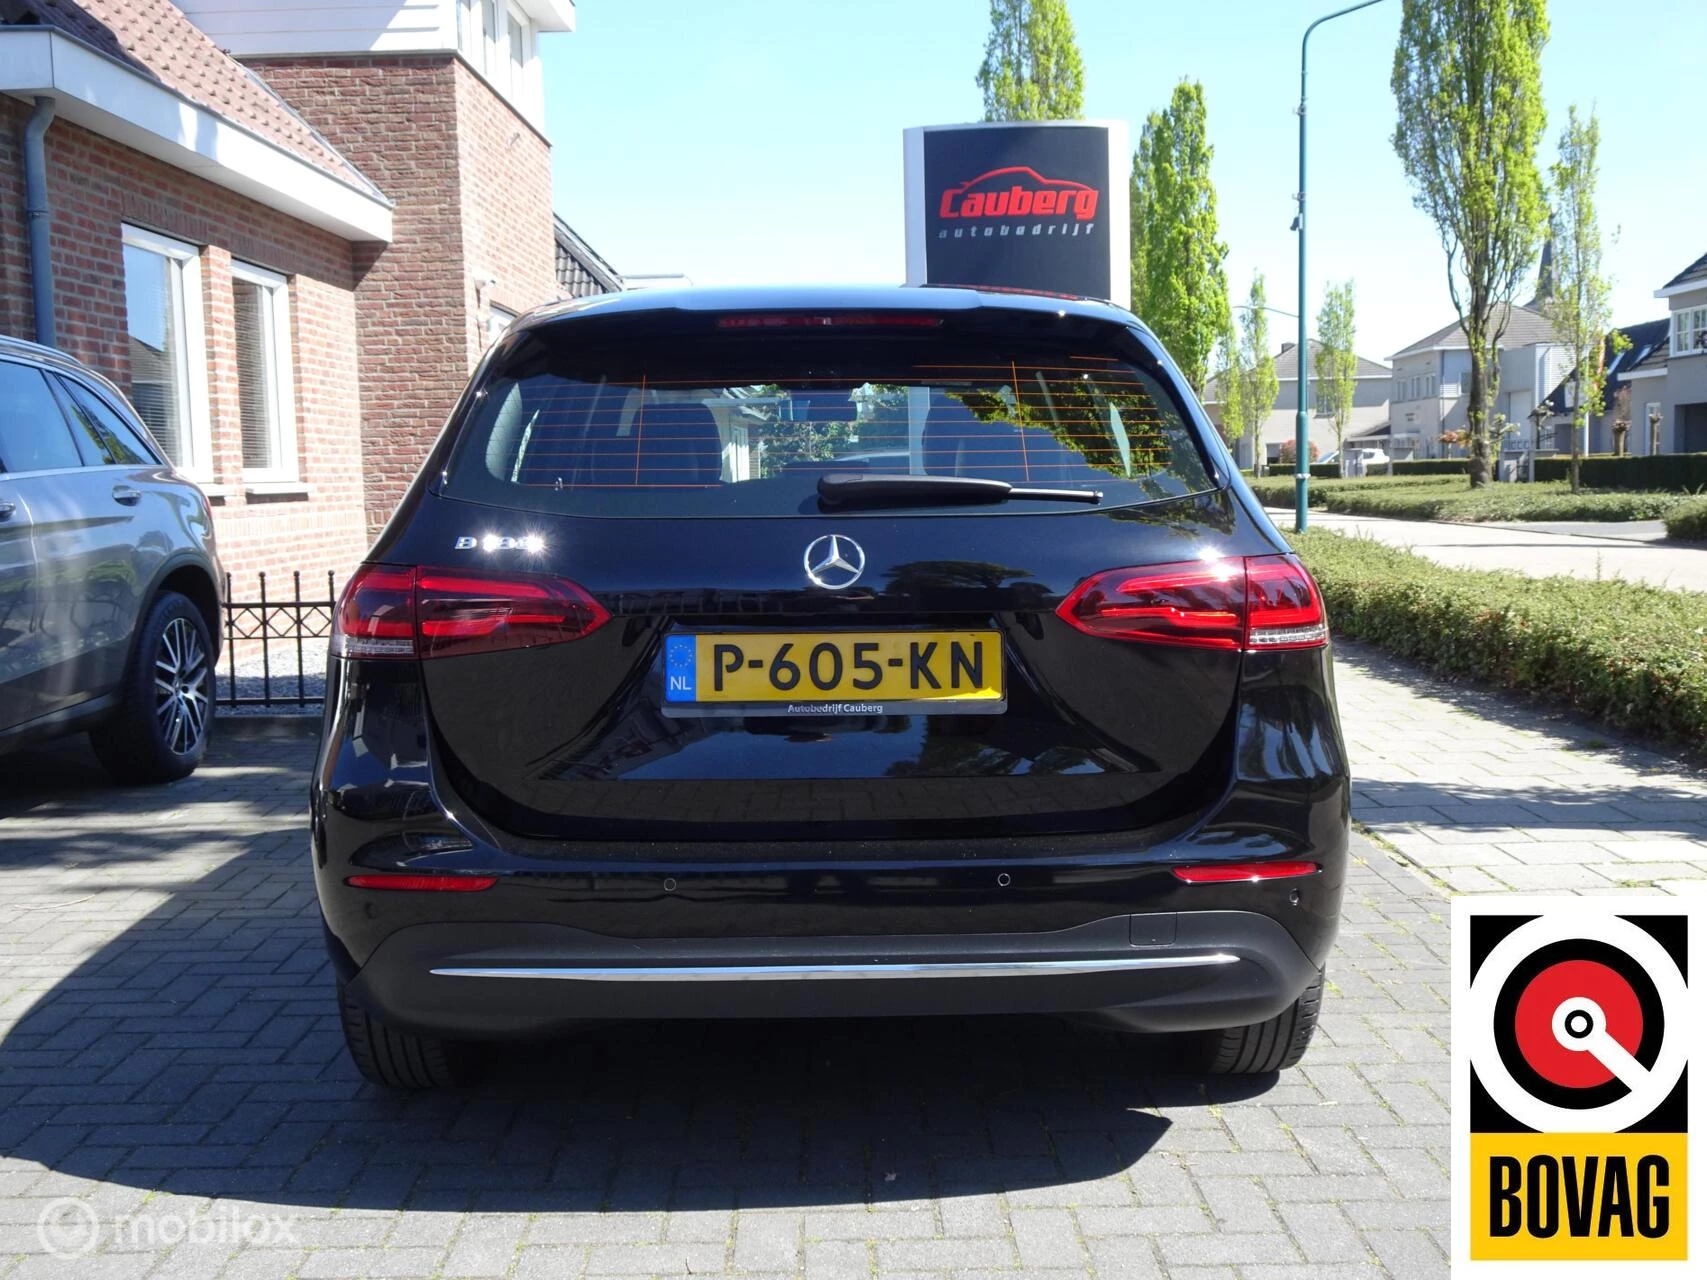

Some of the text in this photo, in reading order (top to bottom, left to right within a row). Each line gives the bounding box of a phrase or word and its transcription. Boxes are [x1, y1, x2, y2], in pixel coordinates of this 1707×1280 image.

[939, 186, 1099, 220] Cauberg
[713, 641, 984, 692] P-605-KN
[670, 676, 692, 691] NL
[787, 703, 884, 715] Autobedrijf Cauberg
